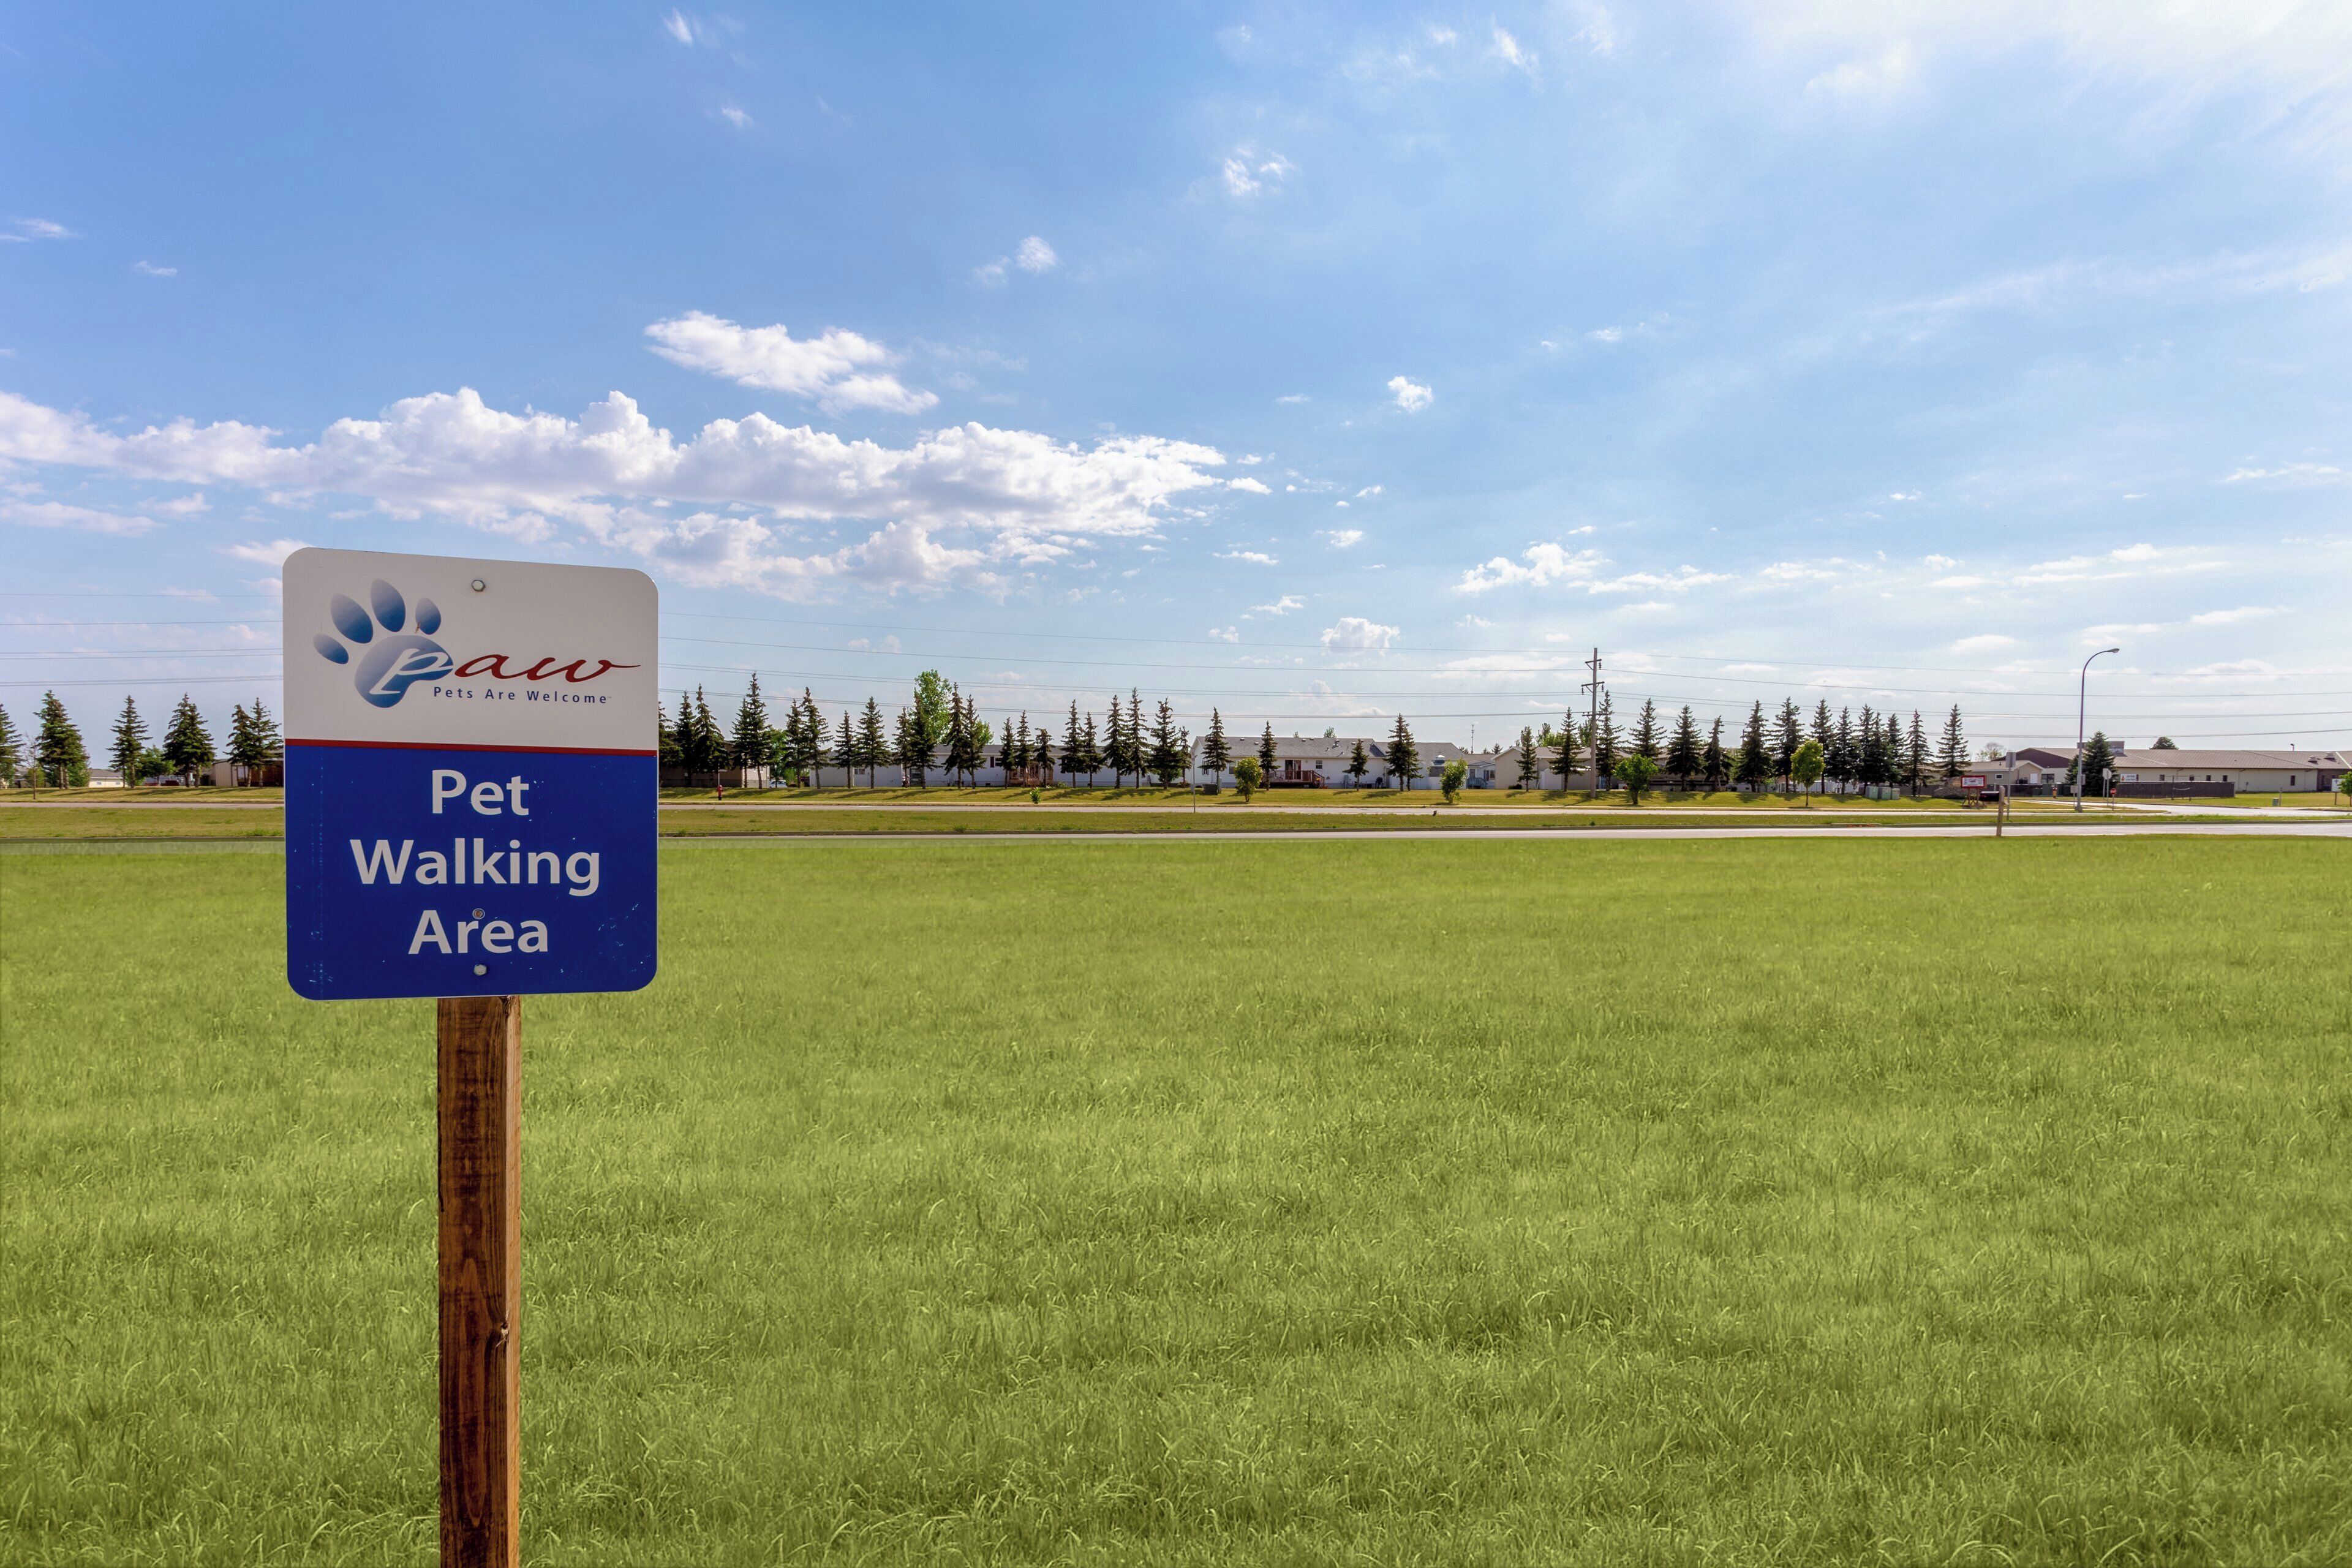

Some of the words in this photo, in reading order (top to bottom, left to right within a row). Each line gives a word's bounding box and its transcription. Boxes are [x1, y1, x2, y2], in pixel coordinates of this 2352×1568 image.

[369, 648, 641, 695] paw
[434, 686, 473, 699] Pets
[484, 688, 515, 700] Are
[526, 690, 606, 704] Welcome
[432, 769, 529, 816] Pet
[349, 837, 600, 897] Walking
[408, 910, 548, 954] Area
